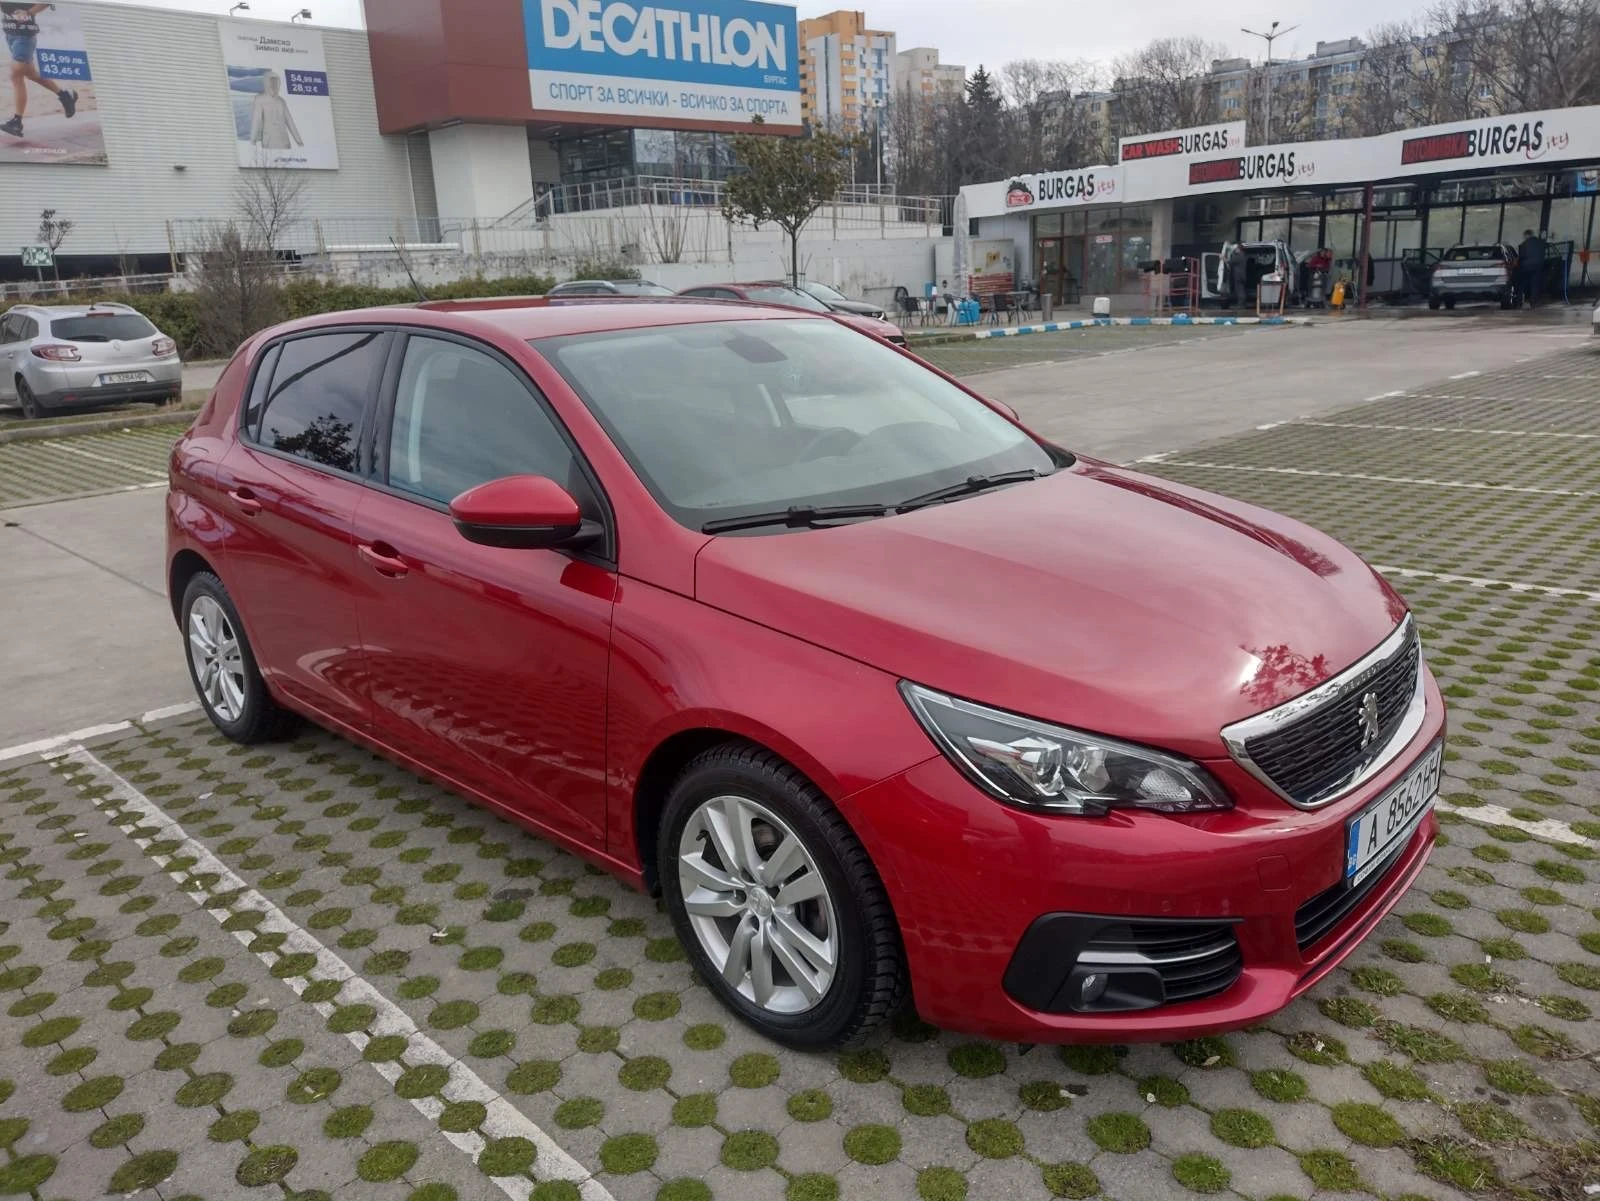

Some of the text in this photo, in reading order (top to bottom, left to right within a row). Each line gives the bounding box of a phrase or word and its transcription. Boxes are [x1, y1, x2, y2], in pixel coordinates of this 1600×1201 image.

[540, 0, 787, 71] DECATHLON
[43, 65, 73, 76] 43,45
[549, 82, 594, 101] СПОРТ
[597, 86, 615, 103] ЗА
[617, 88, 670, 107] ВСИЧКИ
[680, 92, 728, 111] ВСИЧКО
[729, 96, 744, 113] ЗА
[746, 97, 788, 115] СПОРТА
[1122, 144, 1143, 159] CAR
[1144, 137, 1180, 157] WASH
[1178, 129, 1228, 154] BURGAS
[1466, 120, 1544, 157] BURGAS
[1239, 152, 1295, 180] BURGAS
[1039, 174, 1095, 201] BURGAS
